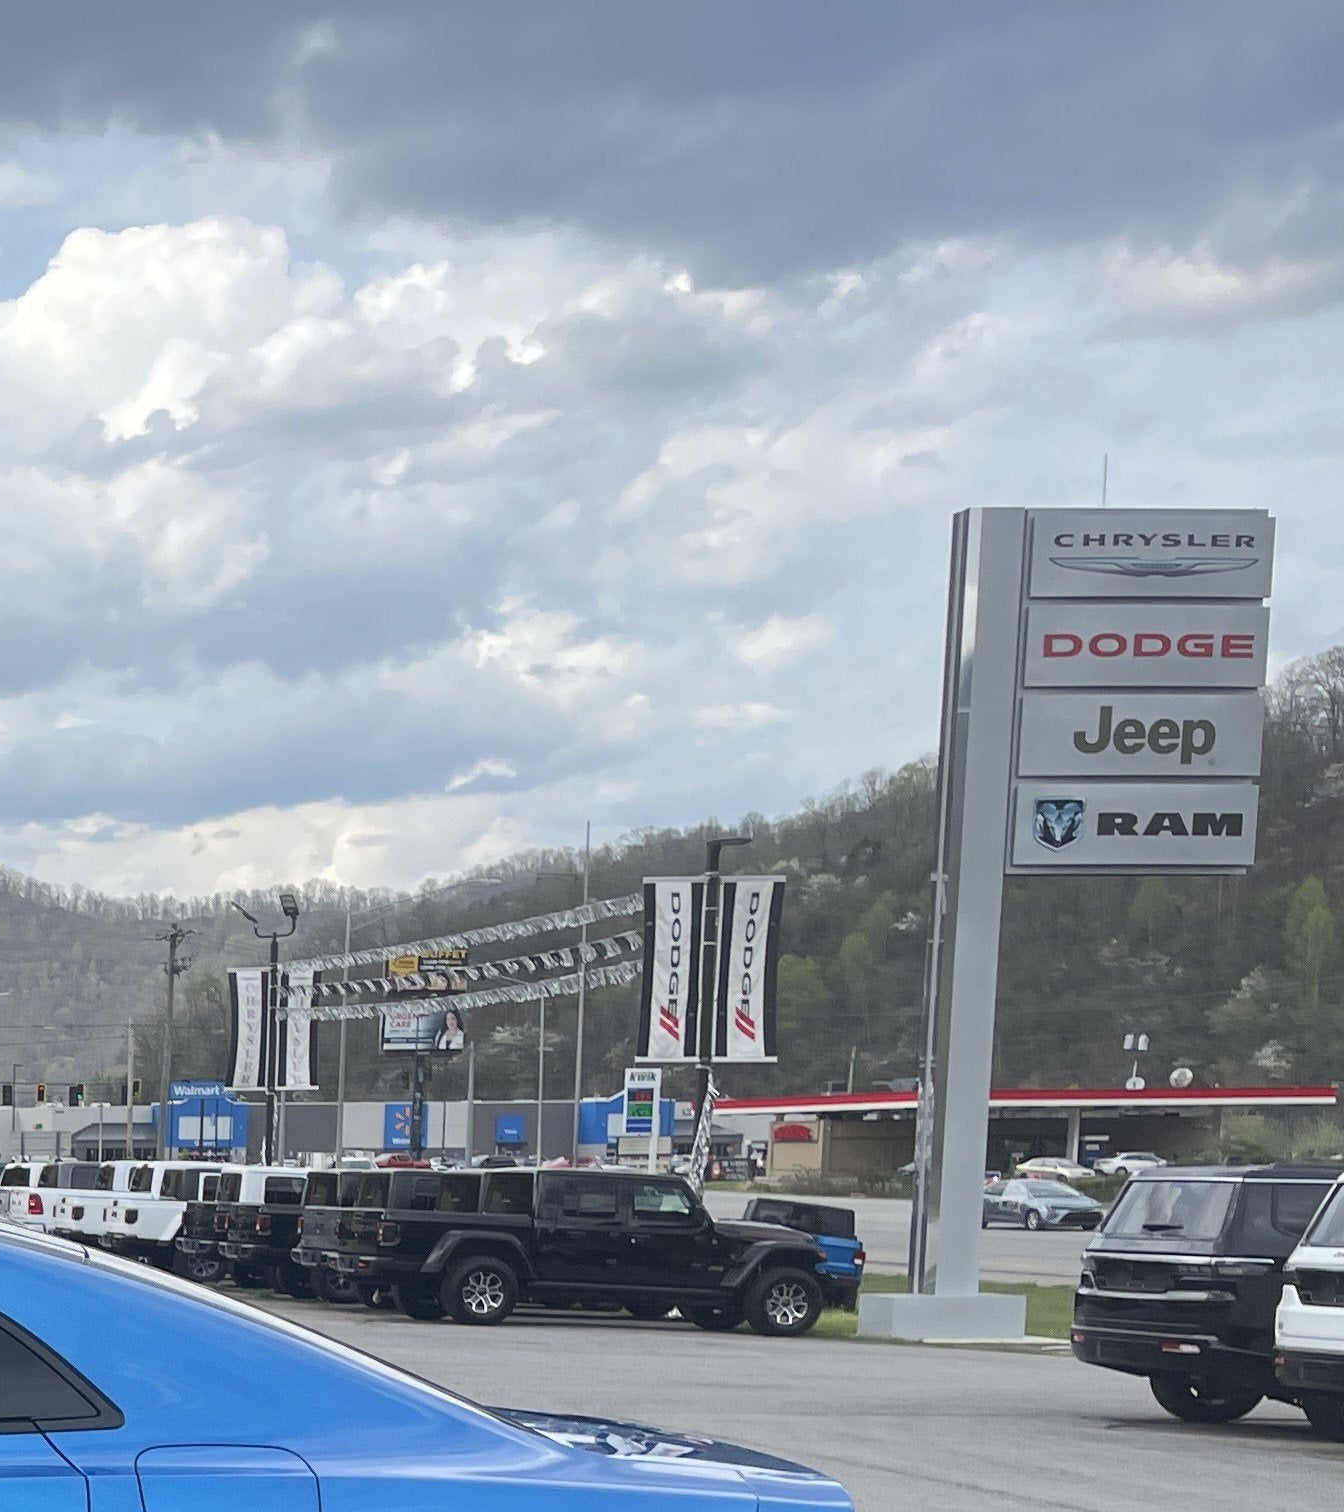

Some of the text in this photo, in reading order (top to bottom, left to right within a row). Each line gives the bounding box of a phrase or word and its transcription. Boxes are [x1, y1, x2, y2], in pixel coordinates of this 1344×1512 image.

[1053, 533, 1255, 548] CHRYSLER
[1042, 633, 1255, 659] DODGE
[1073, 706, 1217, 765] Jeep
[1096, 812, 1244, 837] RAM
[667, 892, 682, 1020] DODGE
[740, 892, 760, 1020] DODGE
[173, 1085, 220, 1096] Walmart
